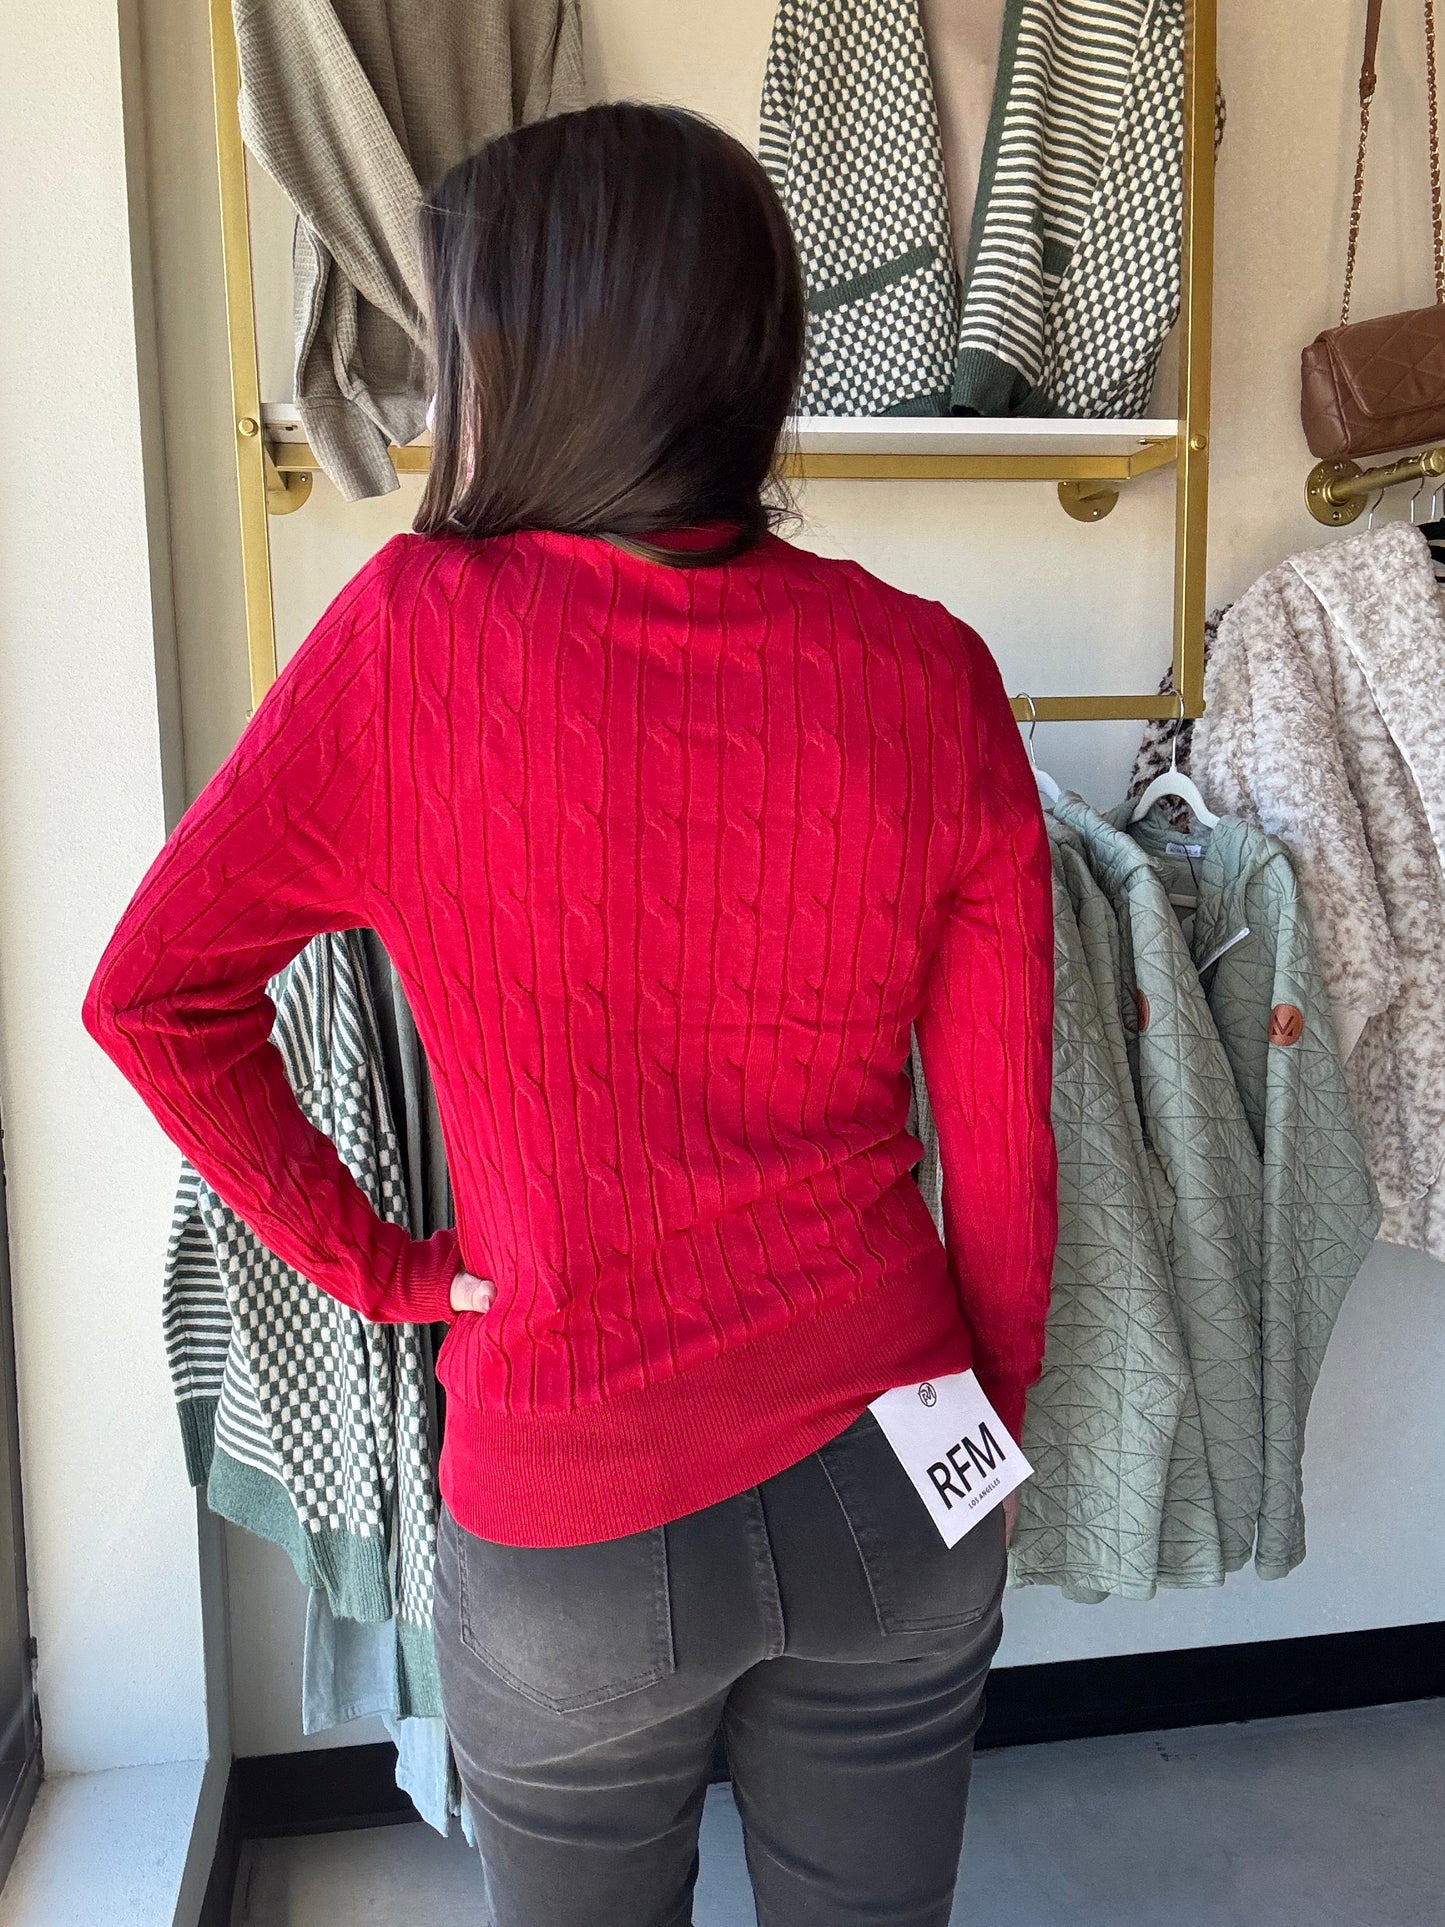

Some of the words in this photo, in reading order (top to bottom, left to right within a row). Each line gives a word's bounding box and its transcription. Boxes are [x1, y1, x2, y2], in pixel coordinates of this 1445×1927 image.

[926, 1421, 1006, 1510] RFM
[968, 1497, 980, 1509] LOS
[979, 1477, 1001, 1500] ANGELES
